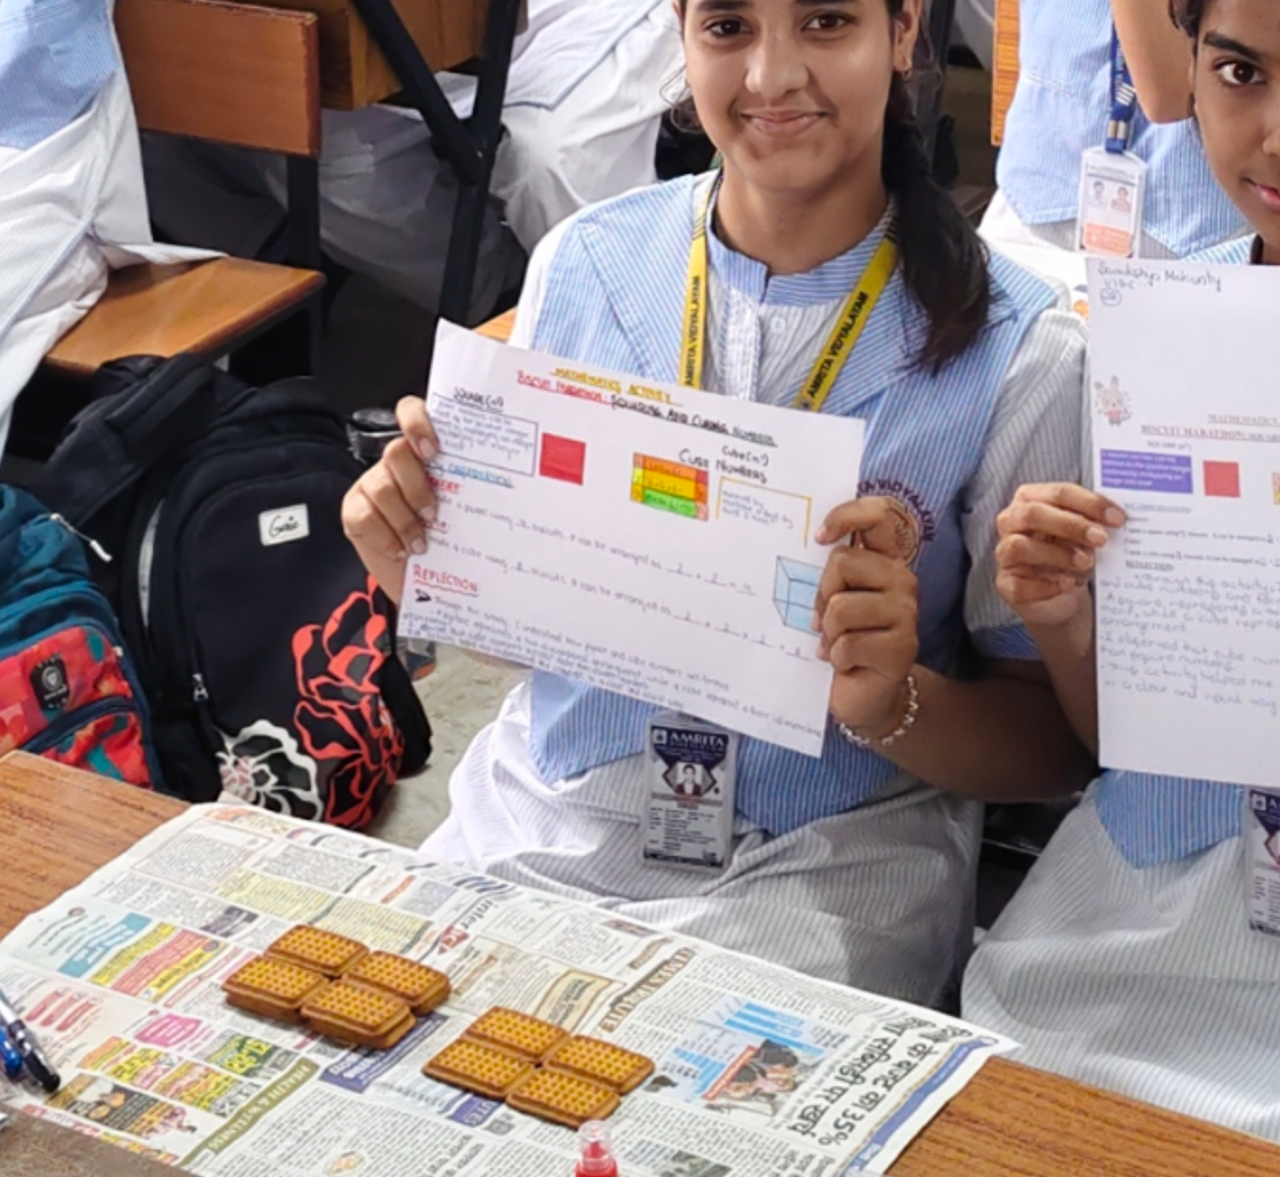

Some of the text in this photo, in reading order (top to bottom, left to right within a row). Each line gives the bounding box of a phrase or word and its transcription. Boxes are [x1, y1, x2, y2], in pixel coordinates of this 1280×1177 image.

[684, 275, 701, 387] AMRITA VIDYALAYAM
[807, 291, 870, 399] AMRITA VIDYALAYAM
[627, 382, 674, 405] ACTIVITY
[1141, 424, 1181, 435] BISCUIT
[1207, 413, 1279, 427] MATHEMATICS
[412, 563, 479, 593] REFLECTION
[1200, 669, 1247, 687] helped
[670, 731, 726, 747] AMRITA
[268, 1063, 310, 1100] HEALTH
[210, 1106, 260, 1150] WELLNESS
[817, 1110, 856, 1148] 35%
